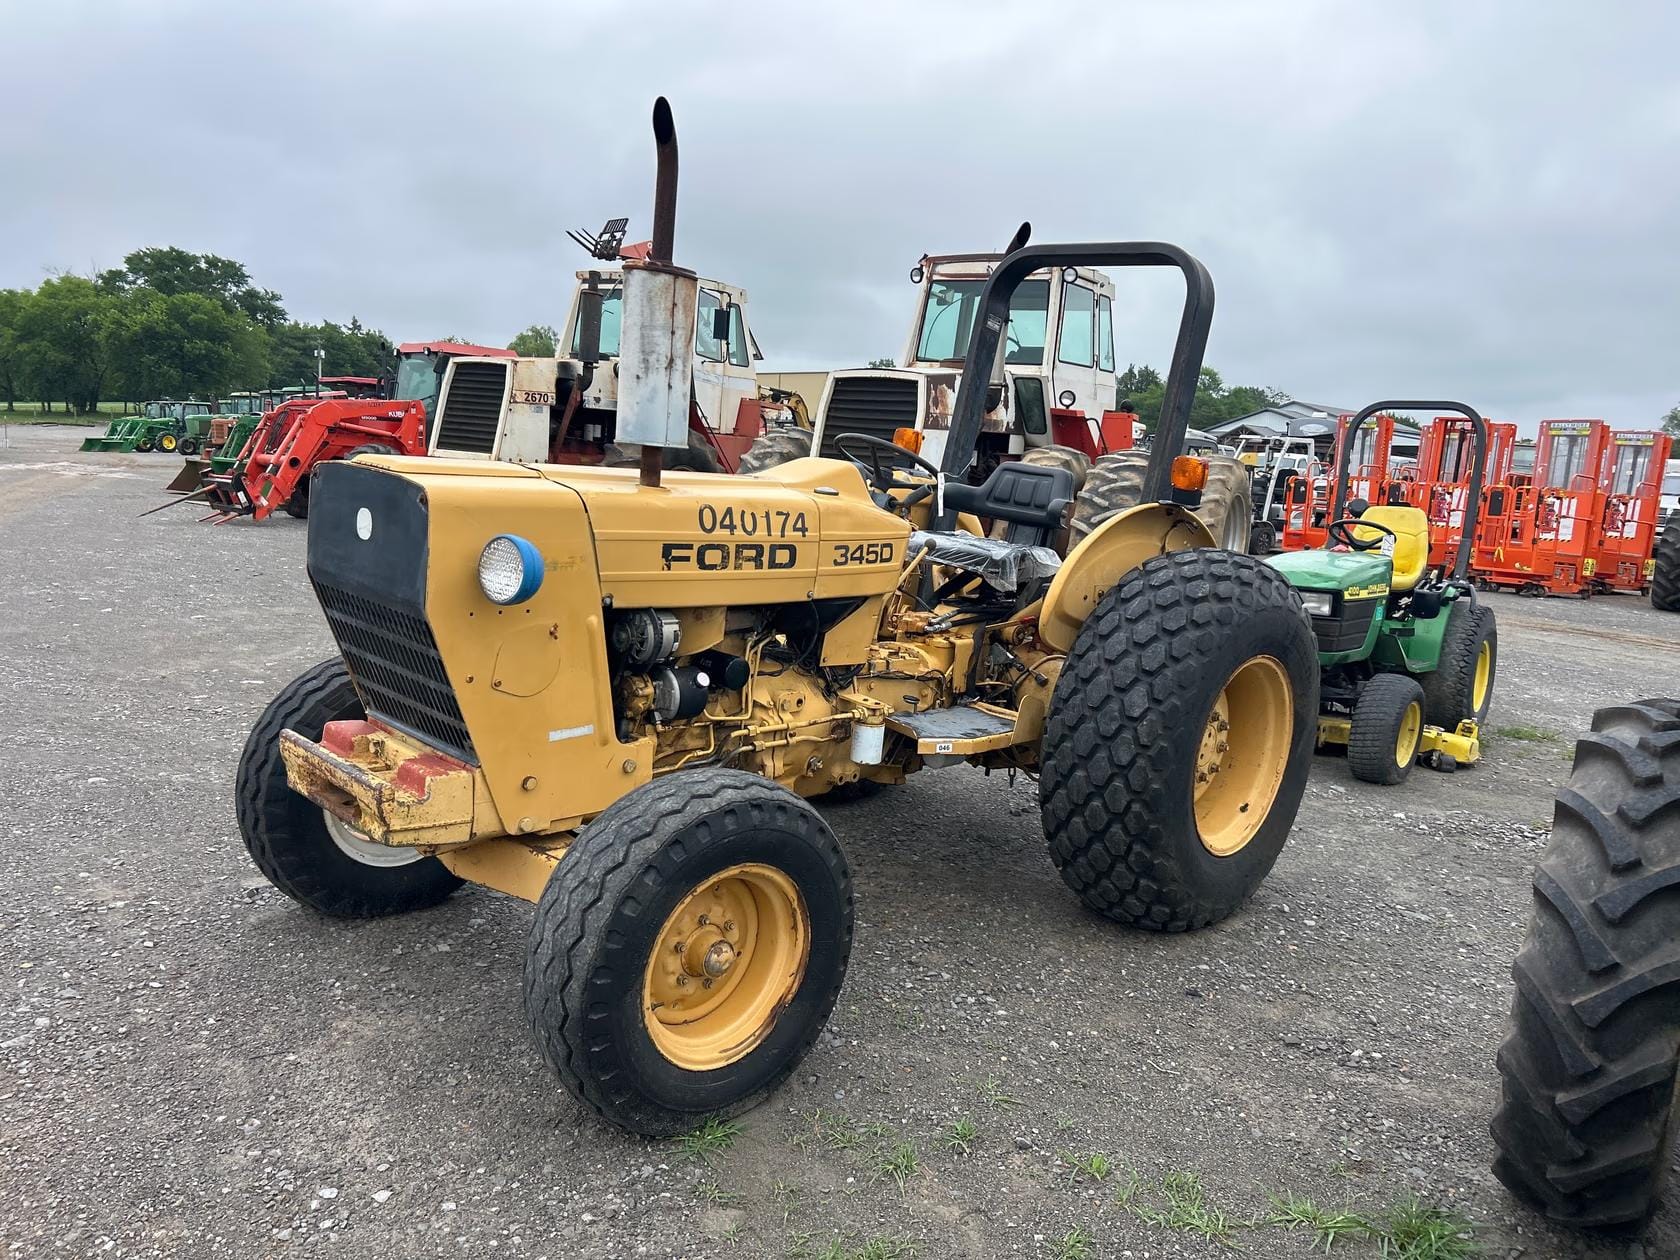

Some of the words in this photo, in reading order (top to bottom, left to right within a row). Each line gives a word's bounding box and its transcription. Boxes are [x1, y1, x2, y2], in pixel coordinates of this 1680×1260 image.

[524, 392, 549, 403] 2670
[388, 410, 404, 418] KUB
[699, 503, 808, 538] 040174
[662, 543, 797, 571] FORD
[833, 542, 894, 567] 345D
